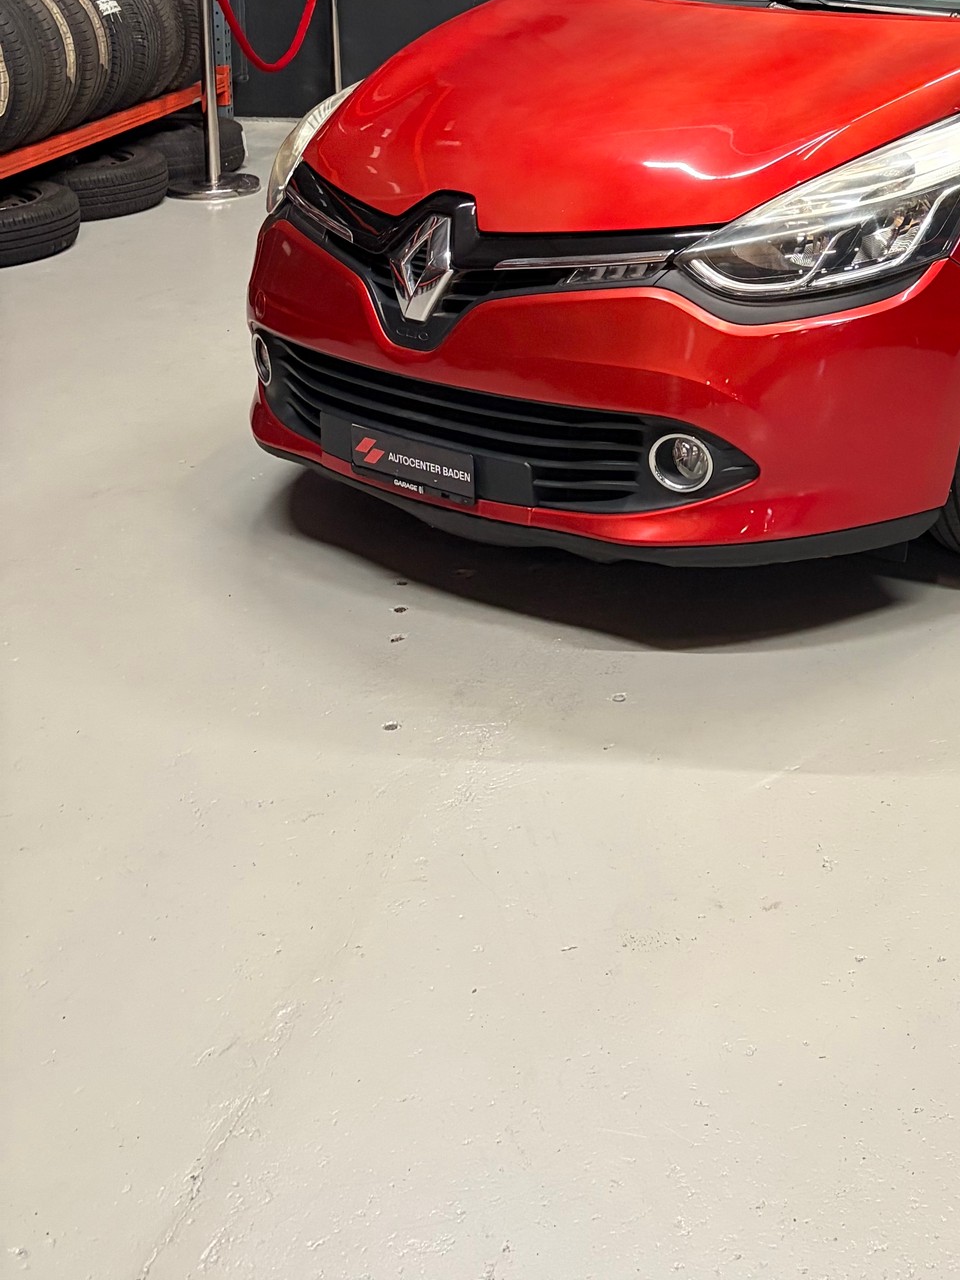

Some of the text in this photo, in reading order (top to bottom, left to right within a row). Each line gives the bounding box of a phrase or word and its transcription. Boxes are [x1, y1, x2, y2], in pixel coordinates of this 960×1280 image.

[388, 452, 471, 482] AUTOCENTER BADEN
[394, 478, 418, 491] GARAGE
